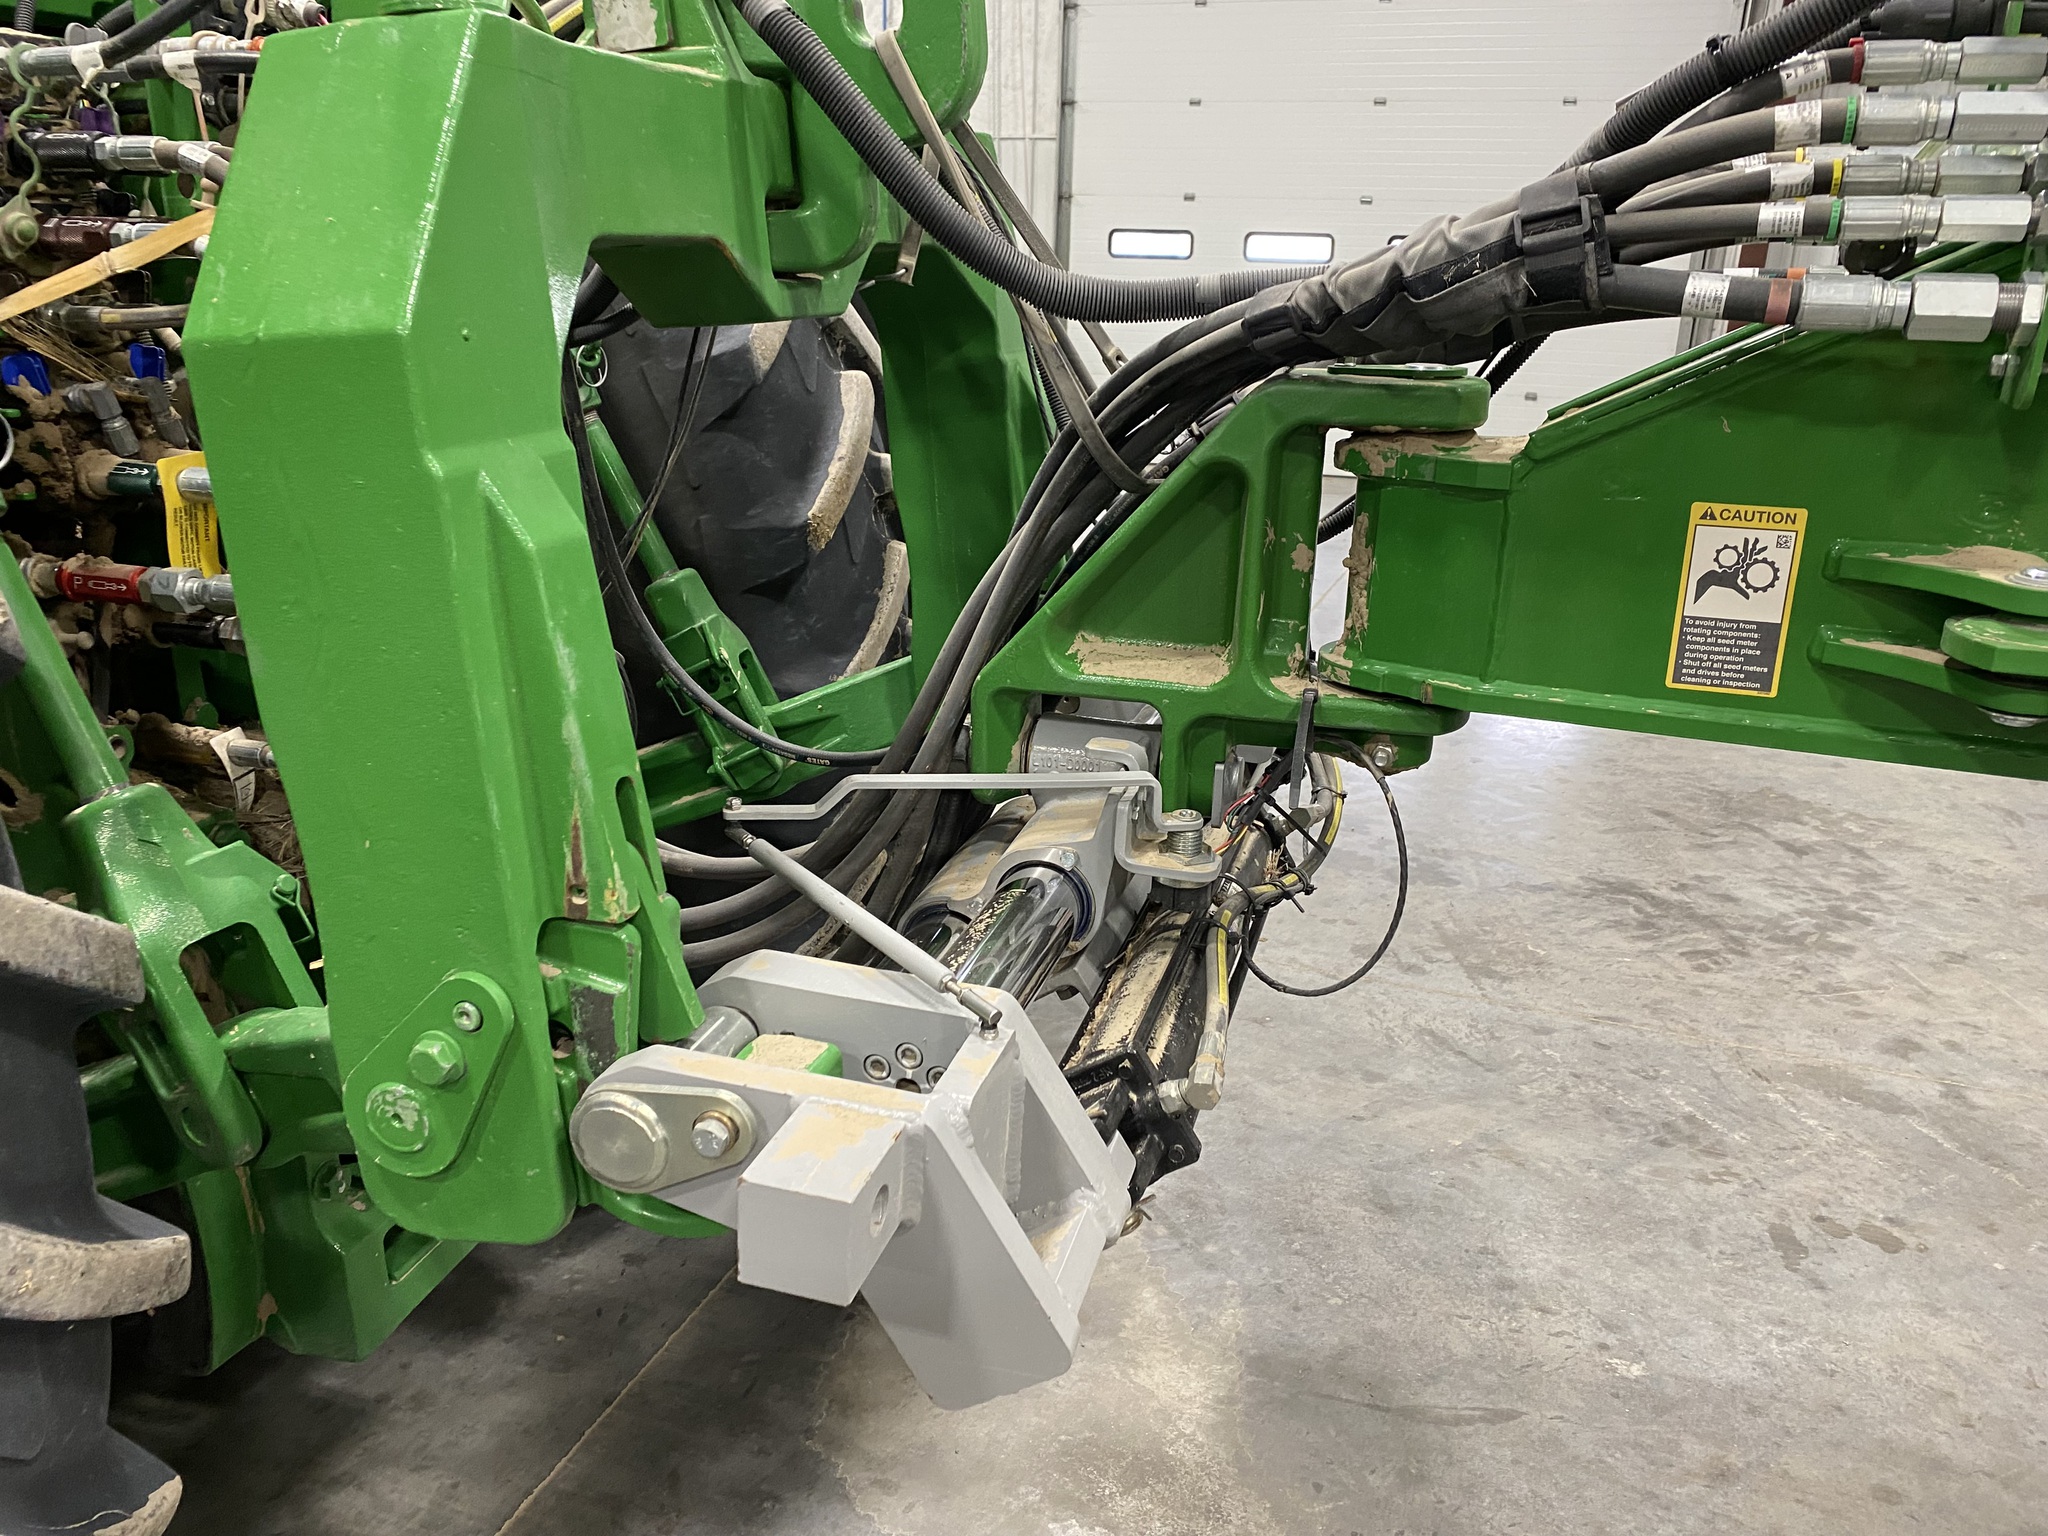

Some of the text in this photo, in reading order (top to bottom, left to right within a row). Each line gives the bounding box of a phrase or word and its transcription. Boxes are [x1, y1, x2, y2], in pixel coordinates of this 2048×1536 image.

[1719, 508, 1797, 525] CAUTION
[1685, 617, 1694, 625] To
[1716, 621, 1738, 629] injury
[1739, 622, 1757, 630] from
[1683, 627, 1761, 639] rotating components:
[1687, 634, 1706, 643] Keep
[1685, 643, 1731, 653] components
[1740, 648, 1761, 656] place
[1684, 651, 1744, 663] during operation
[1683, 659, 1700, 667] Shut
[1742, 665, 1768, 673] meters
[1697, 669, 1720, 677] drives
[1721, 670, 1745, 679] before
[1680, 676, 1711, 685] cleaning
[1722, 679, 1760, 688] inspection
